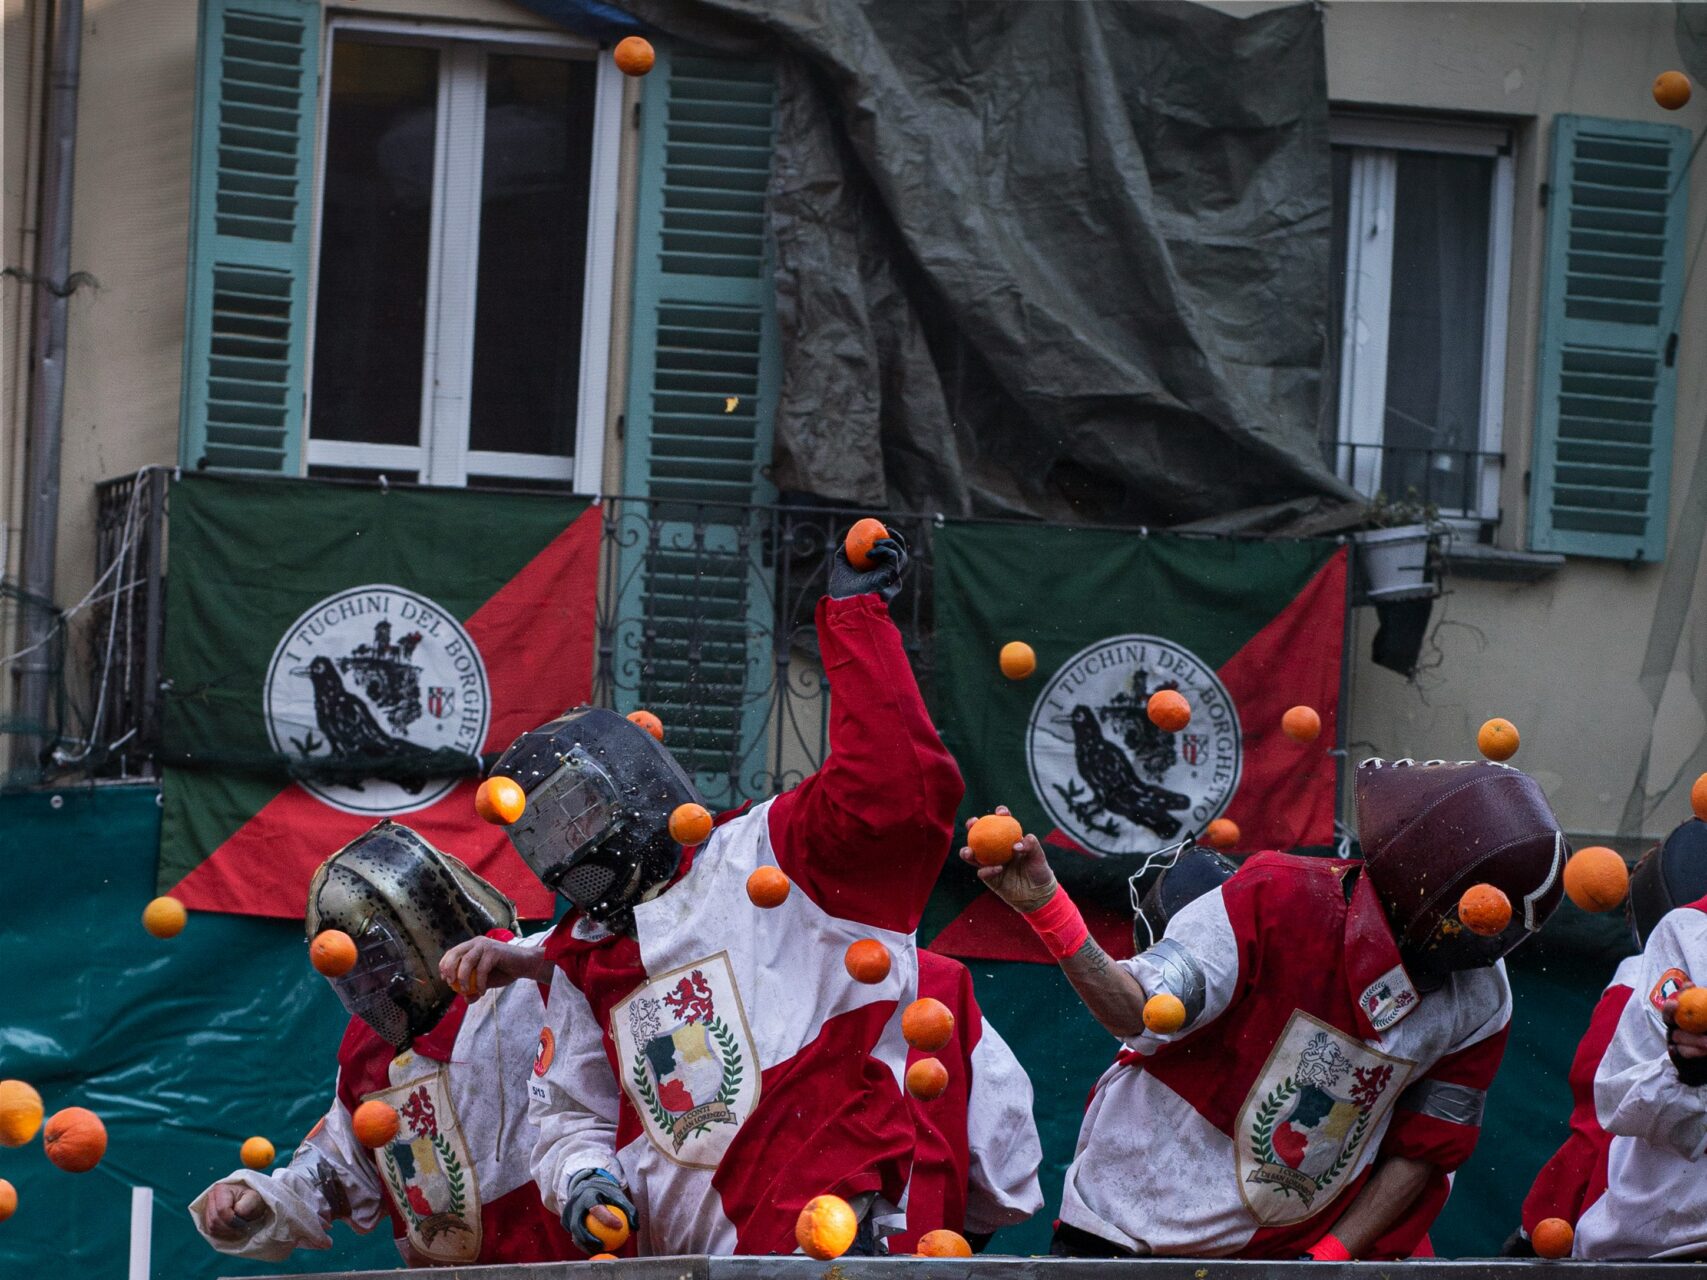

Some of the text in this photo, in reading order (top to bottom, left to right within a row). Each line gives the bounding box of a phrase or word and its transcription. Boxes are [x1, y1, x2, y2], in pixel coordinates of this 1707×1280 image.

[286, 650, 301, 663] I
[297, 596, 389, 648] TUCHINI
[401, 602, 440, 638] DEL
[1048, 646, 1233, 823] I TUCHINI DEL BORGHETTO
